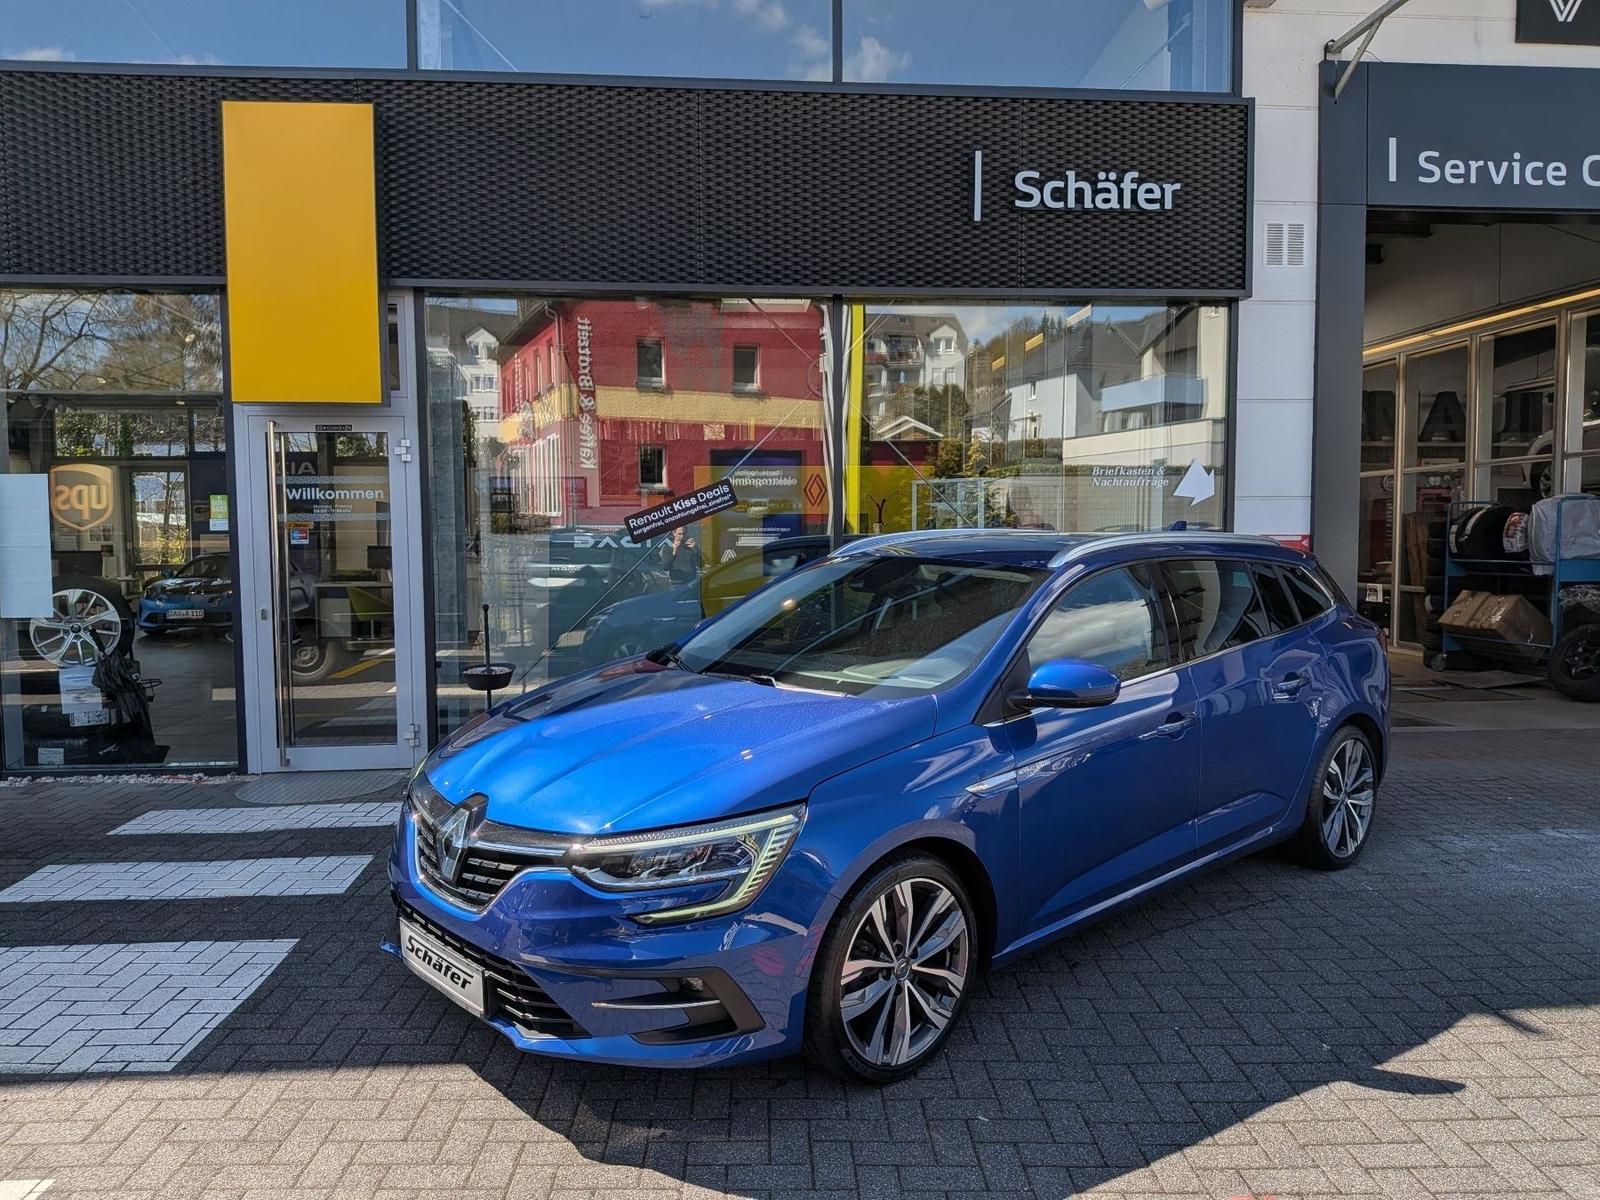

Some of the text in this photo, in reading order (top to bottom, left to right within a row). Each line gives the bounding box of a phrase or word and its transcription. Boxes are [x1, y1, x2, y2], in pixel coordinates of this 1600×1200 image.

[1417, 150, 1567, 187] Service
[1014, 170, 1182, 210] Schäfer
[1091, 466, 1166, 476] Briefkasten &
[286, 487, 384, 500] Willkommen
[628, 505, 673, 529] Renault
[673, 496, 697, 512] Kiss
[697, 484, 730, 503] Deals
[633, 520, 665, 535] sorgenfrei,
[405, 934, 474, 991] Schäfer
